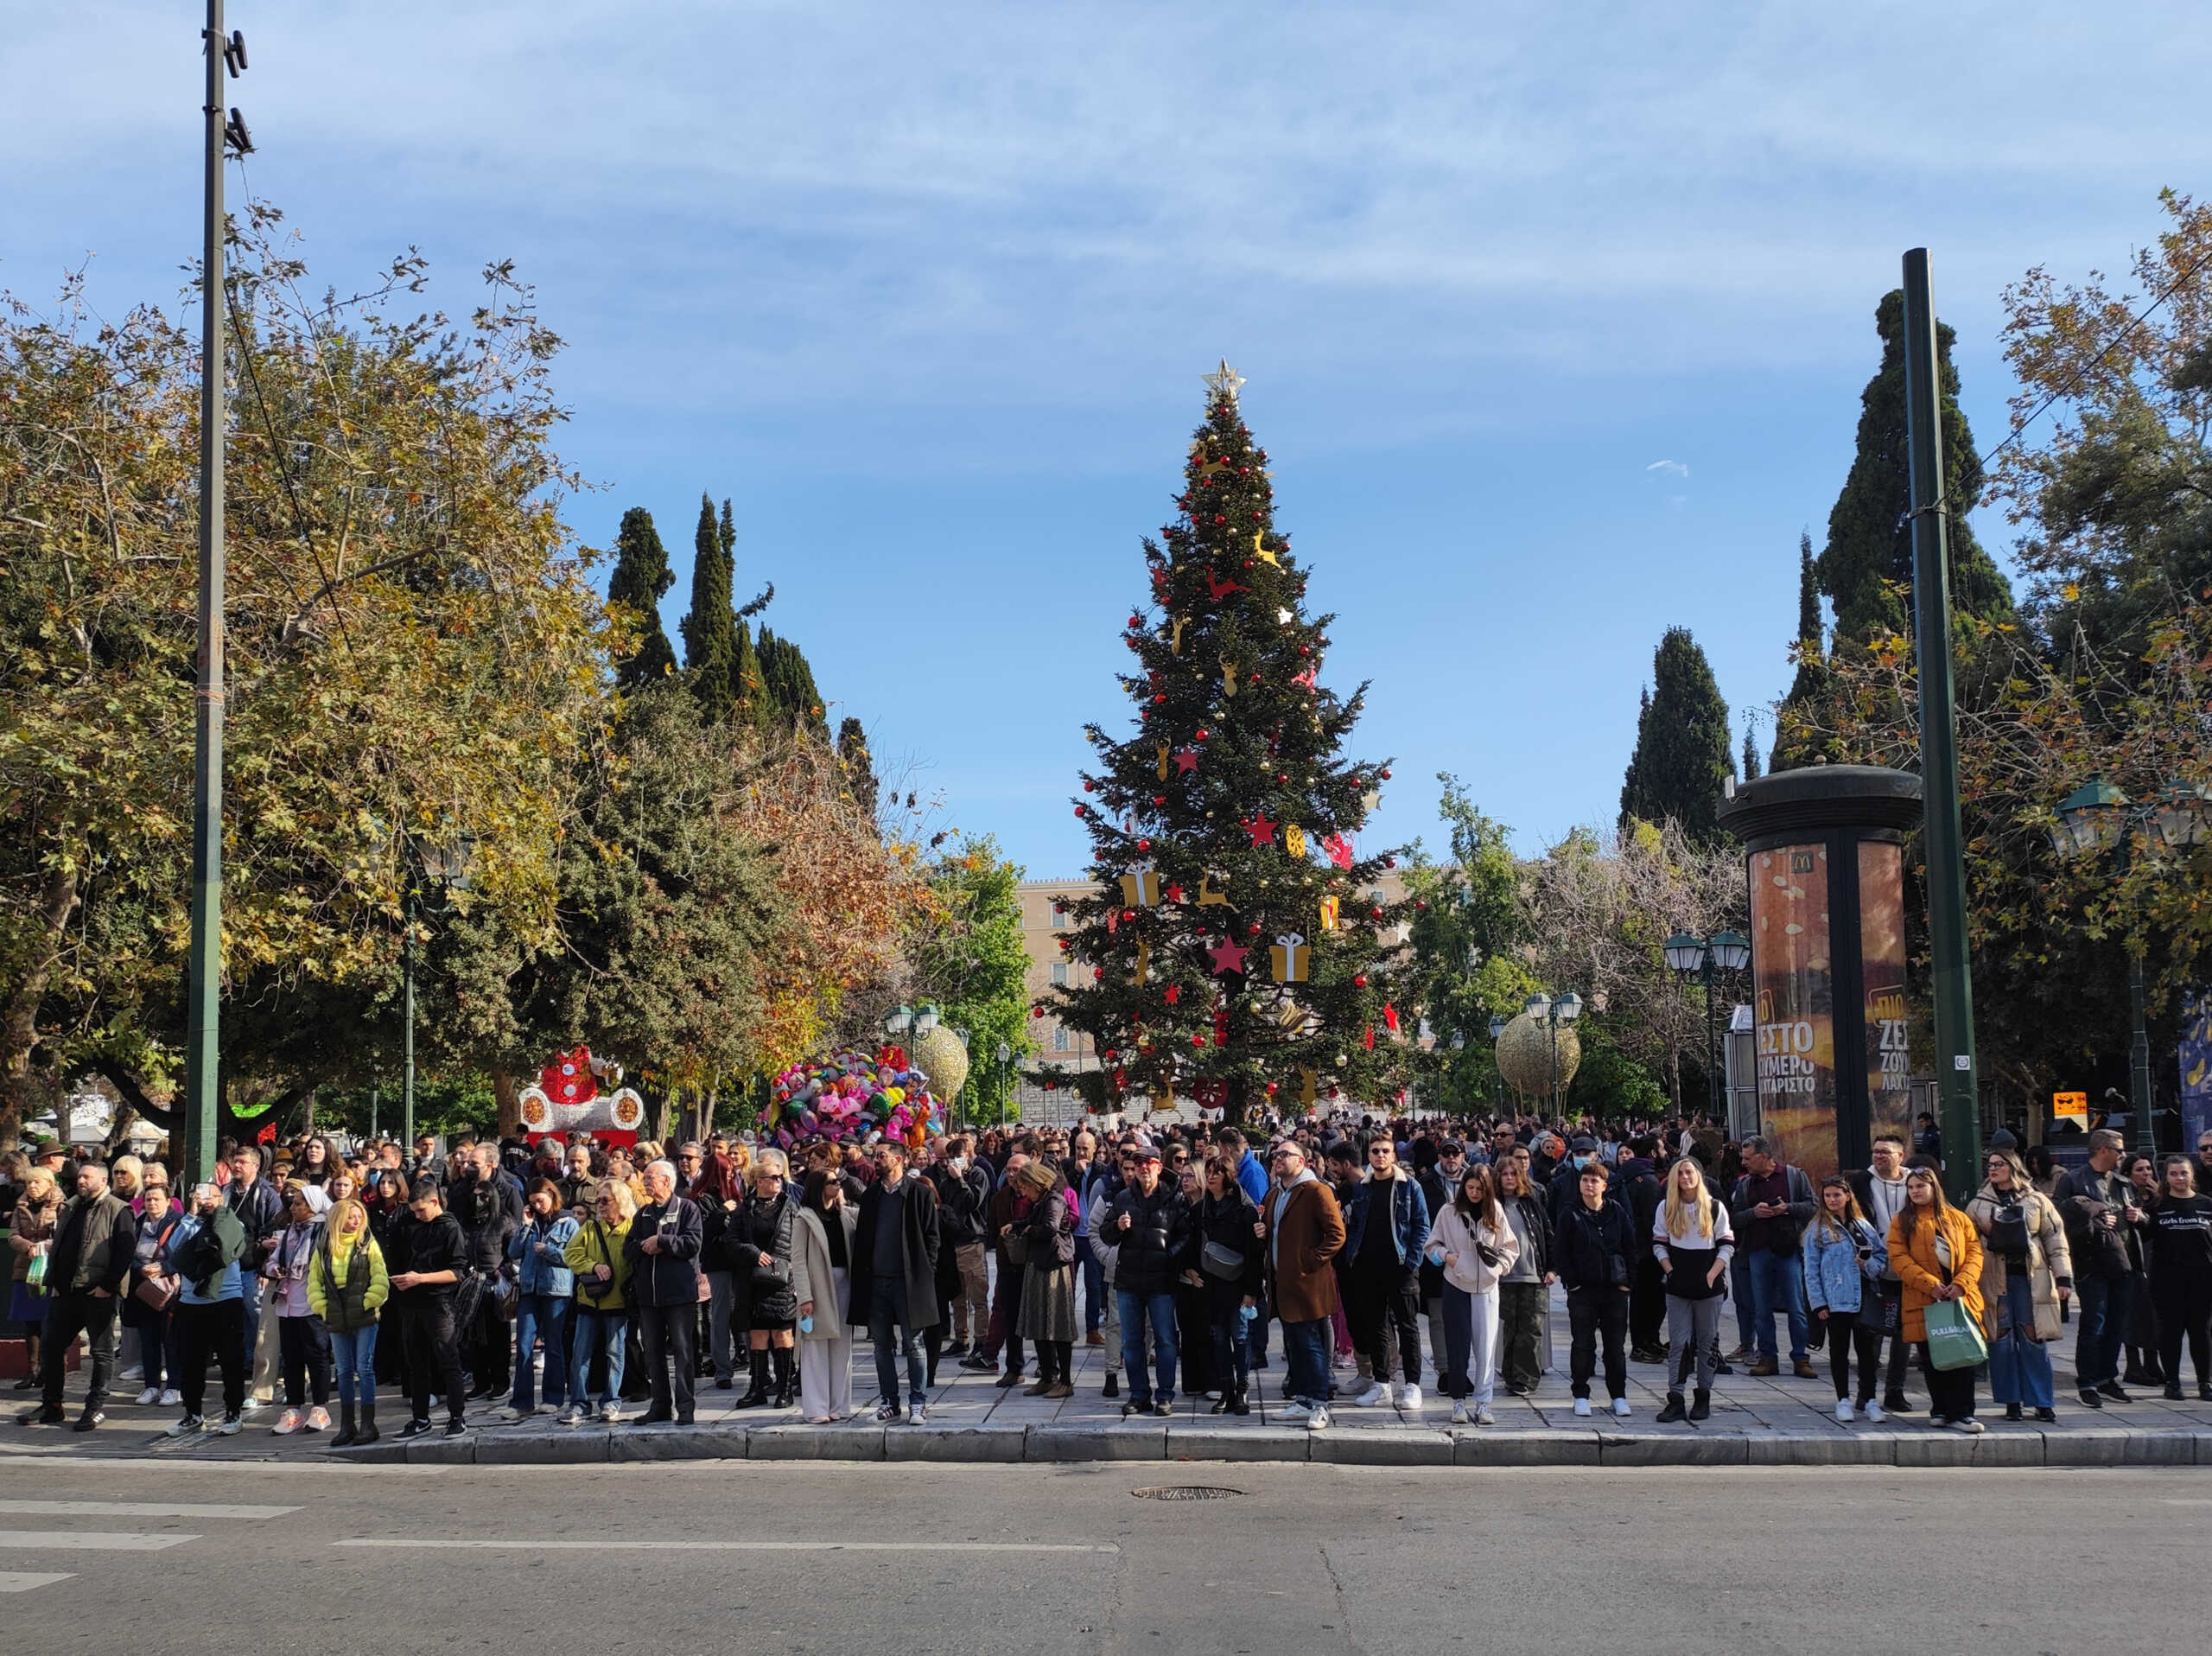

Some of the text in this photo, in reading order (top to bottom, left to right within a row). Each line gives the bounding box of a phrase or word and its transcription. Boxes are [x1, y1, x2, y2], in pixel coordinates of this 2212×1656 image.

[1758, 1022, 1814, 1054] ΕΣΤΟ
[1878, 1020, 1909, 1050] ΖΕΣ
[1758, 1054, 1815, 1076] ΟΥΜΕΡΟ
